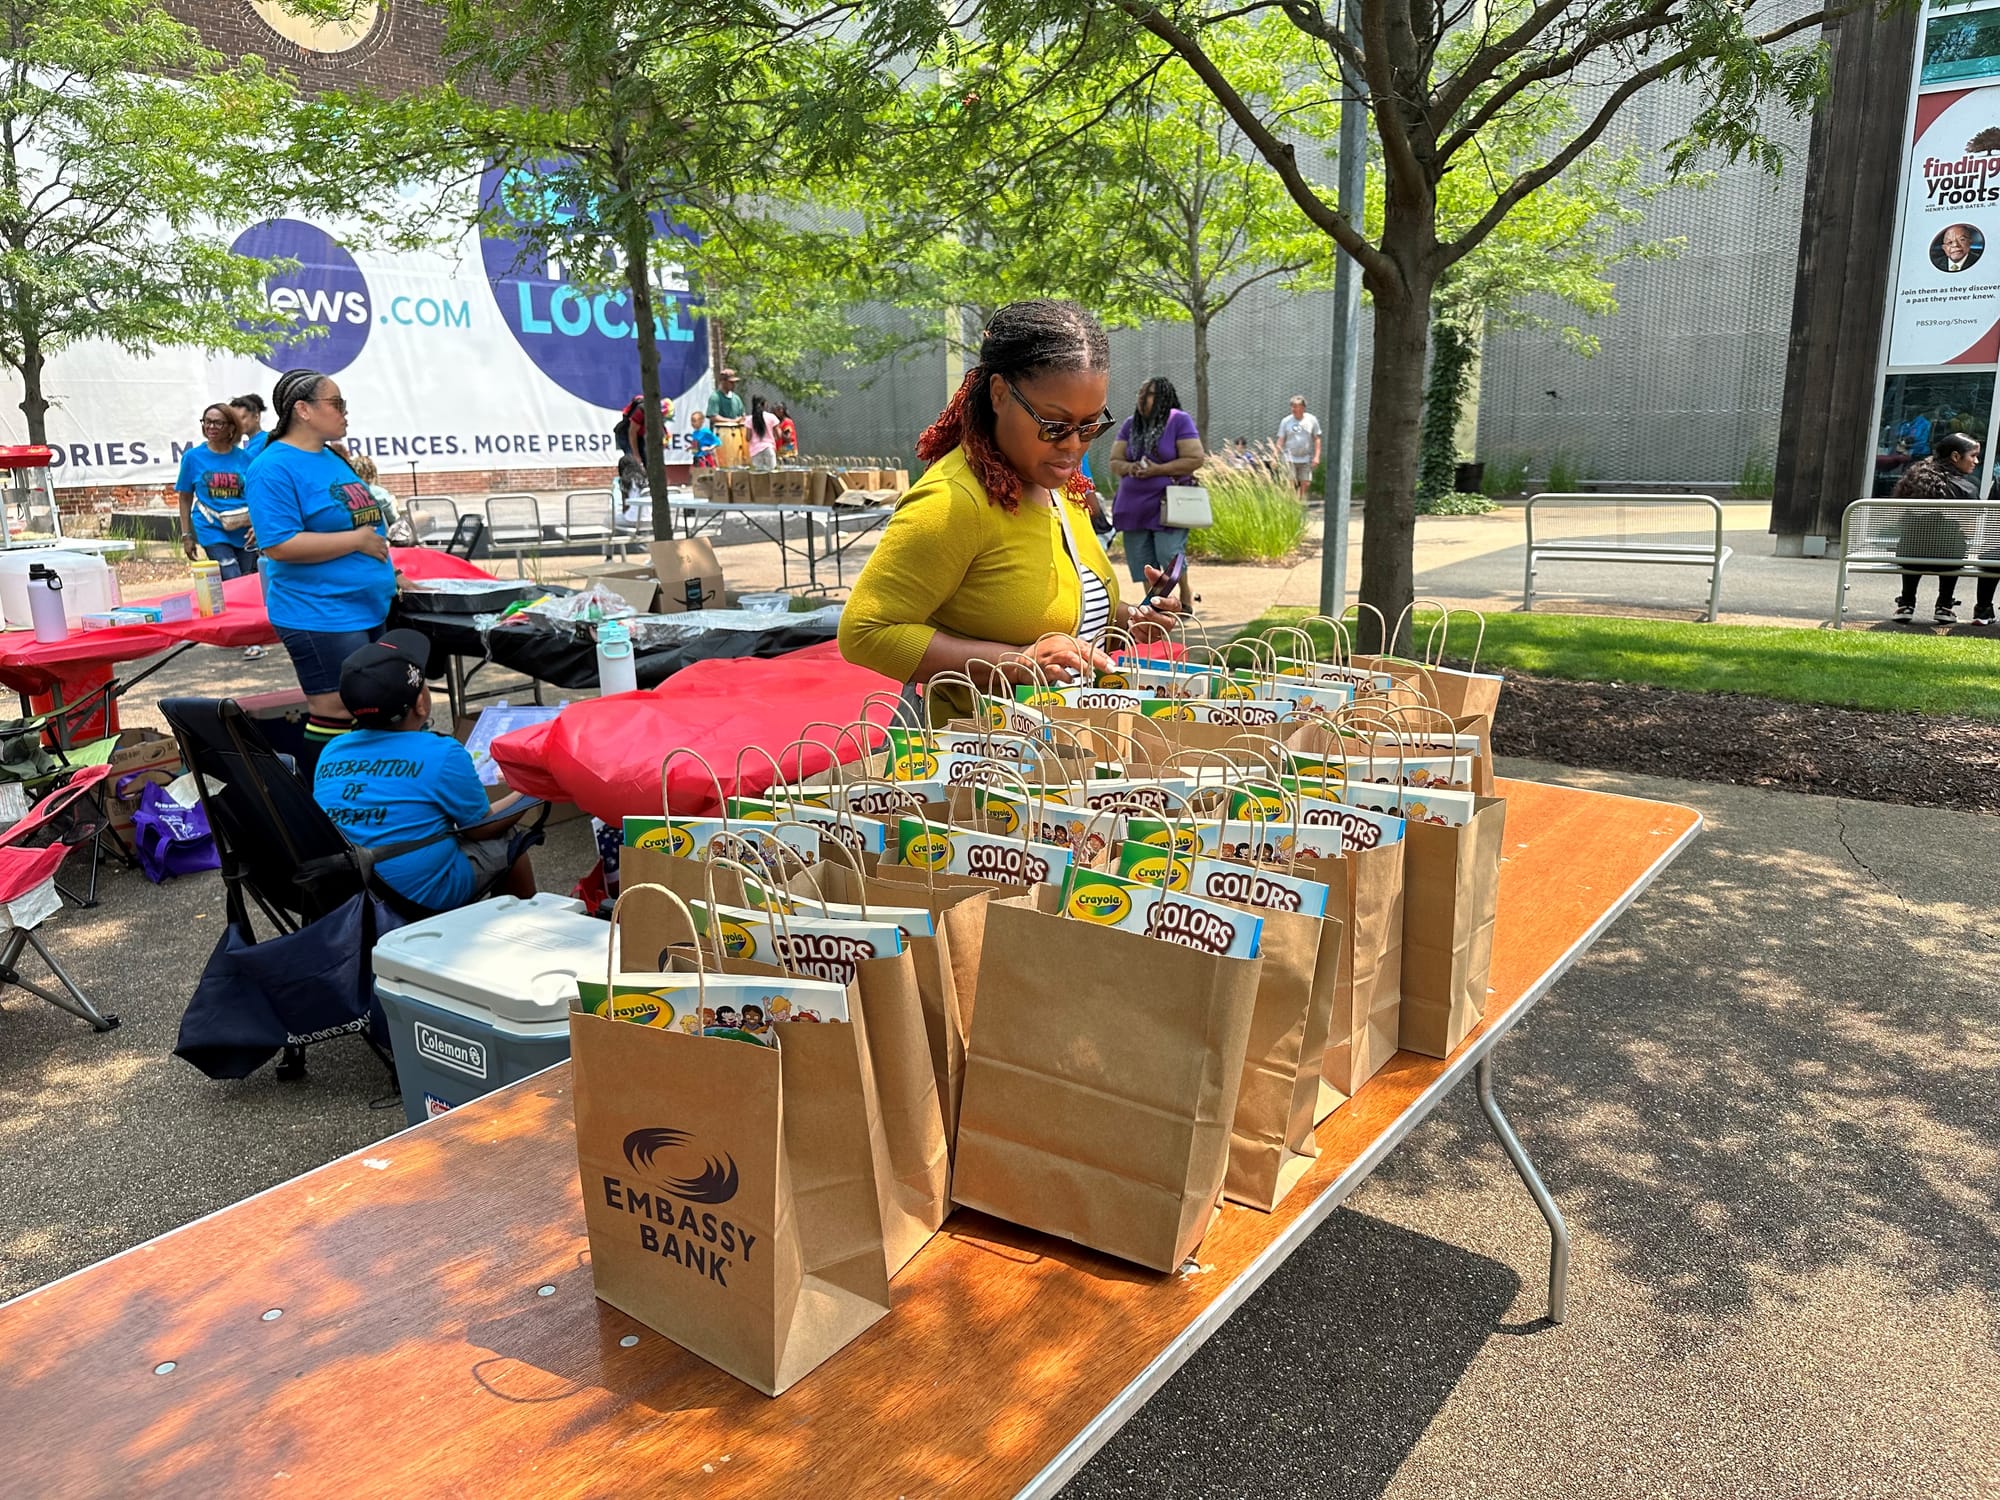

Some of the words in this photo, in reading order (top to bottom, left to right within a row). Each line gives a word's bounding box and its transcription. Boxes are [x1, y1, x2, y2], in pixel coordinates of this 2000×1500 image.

[1923, 155, 2000, 178] finding
[1926, 174, 1979, 199] your
[1938, 187, 2000, 206] roots
[1949, 286, 1967, 294] they
[1968, 284, 2000, 292] discover
[260, 286, 369, 325] ews
[1912, 297, 1928, 305] past
[379, 296, 471, 329] .COM
[1916, 319, 1978, 327] PBS39.org/Shows
[50, 441, 161, 468] ORIES.
[474, 434, 540, 453] MORE
[1079, 694, 1139, 709] COLORS
[1209, 707, 1277, 725] COLORS
[900, 760, 930, 769] Cryol
[342, 782, 368, 801] OF
[326, 805, 388, 826] BERTY
[643, 835, 682, 849] Crayla
[913, 843, 945, 854] Craola
[968, 846, 1047, 881] COLORS
[1138, 867, 1178, 878] Craya
[1078, 894, 1120, 905] Crayola
[1208, 874, 1300, 912] COLORS
[1149, 902, 1234, 948] COLORS
[773, 935, 873, 961] COLORS
[342, 1010, 371, 1033] NGE
[312, 1026, 344, 1041] QUAD
[421, 1029, 469, 1062] Coleman
[603, 1175, 757, 1263] EMBASSY
